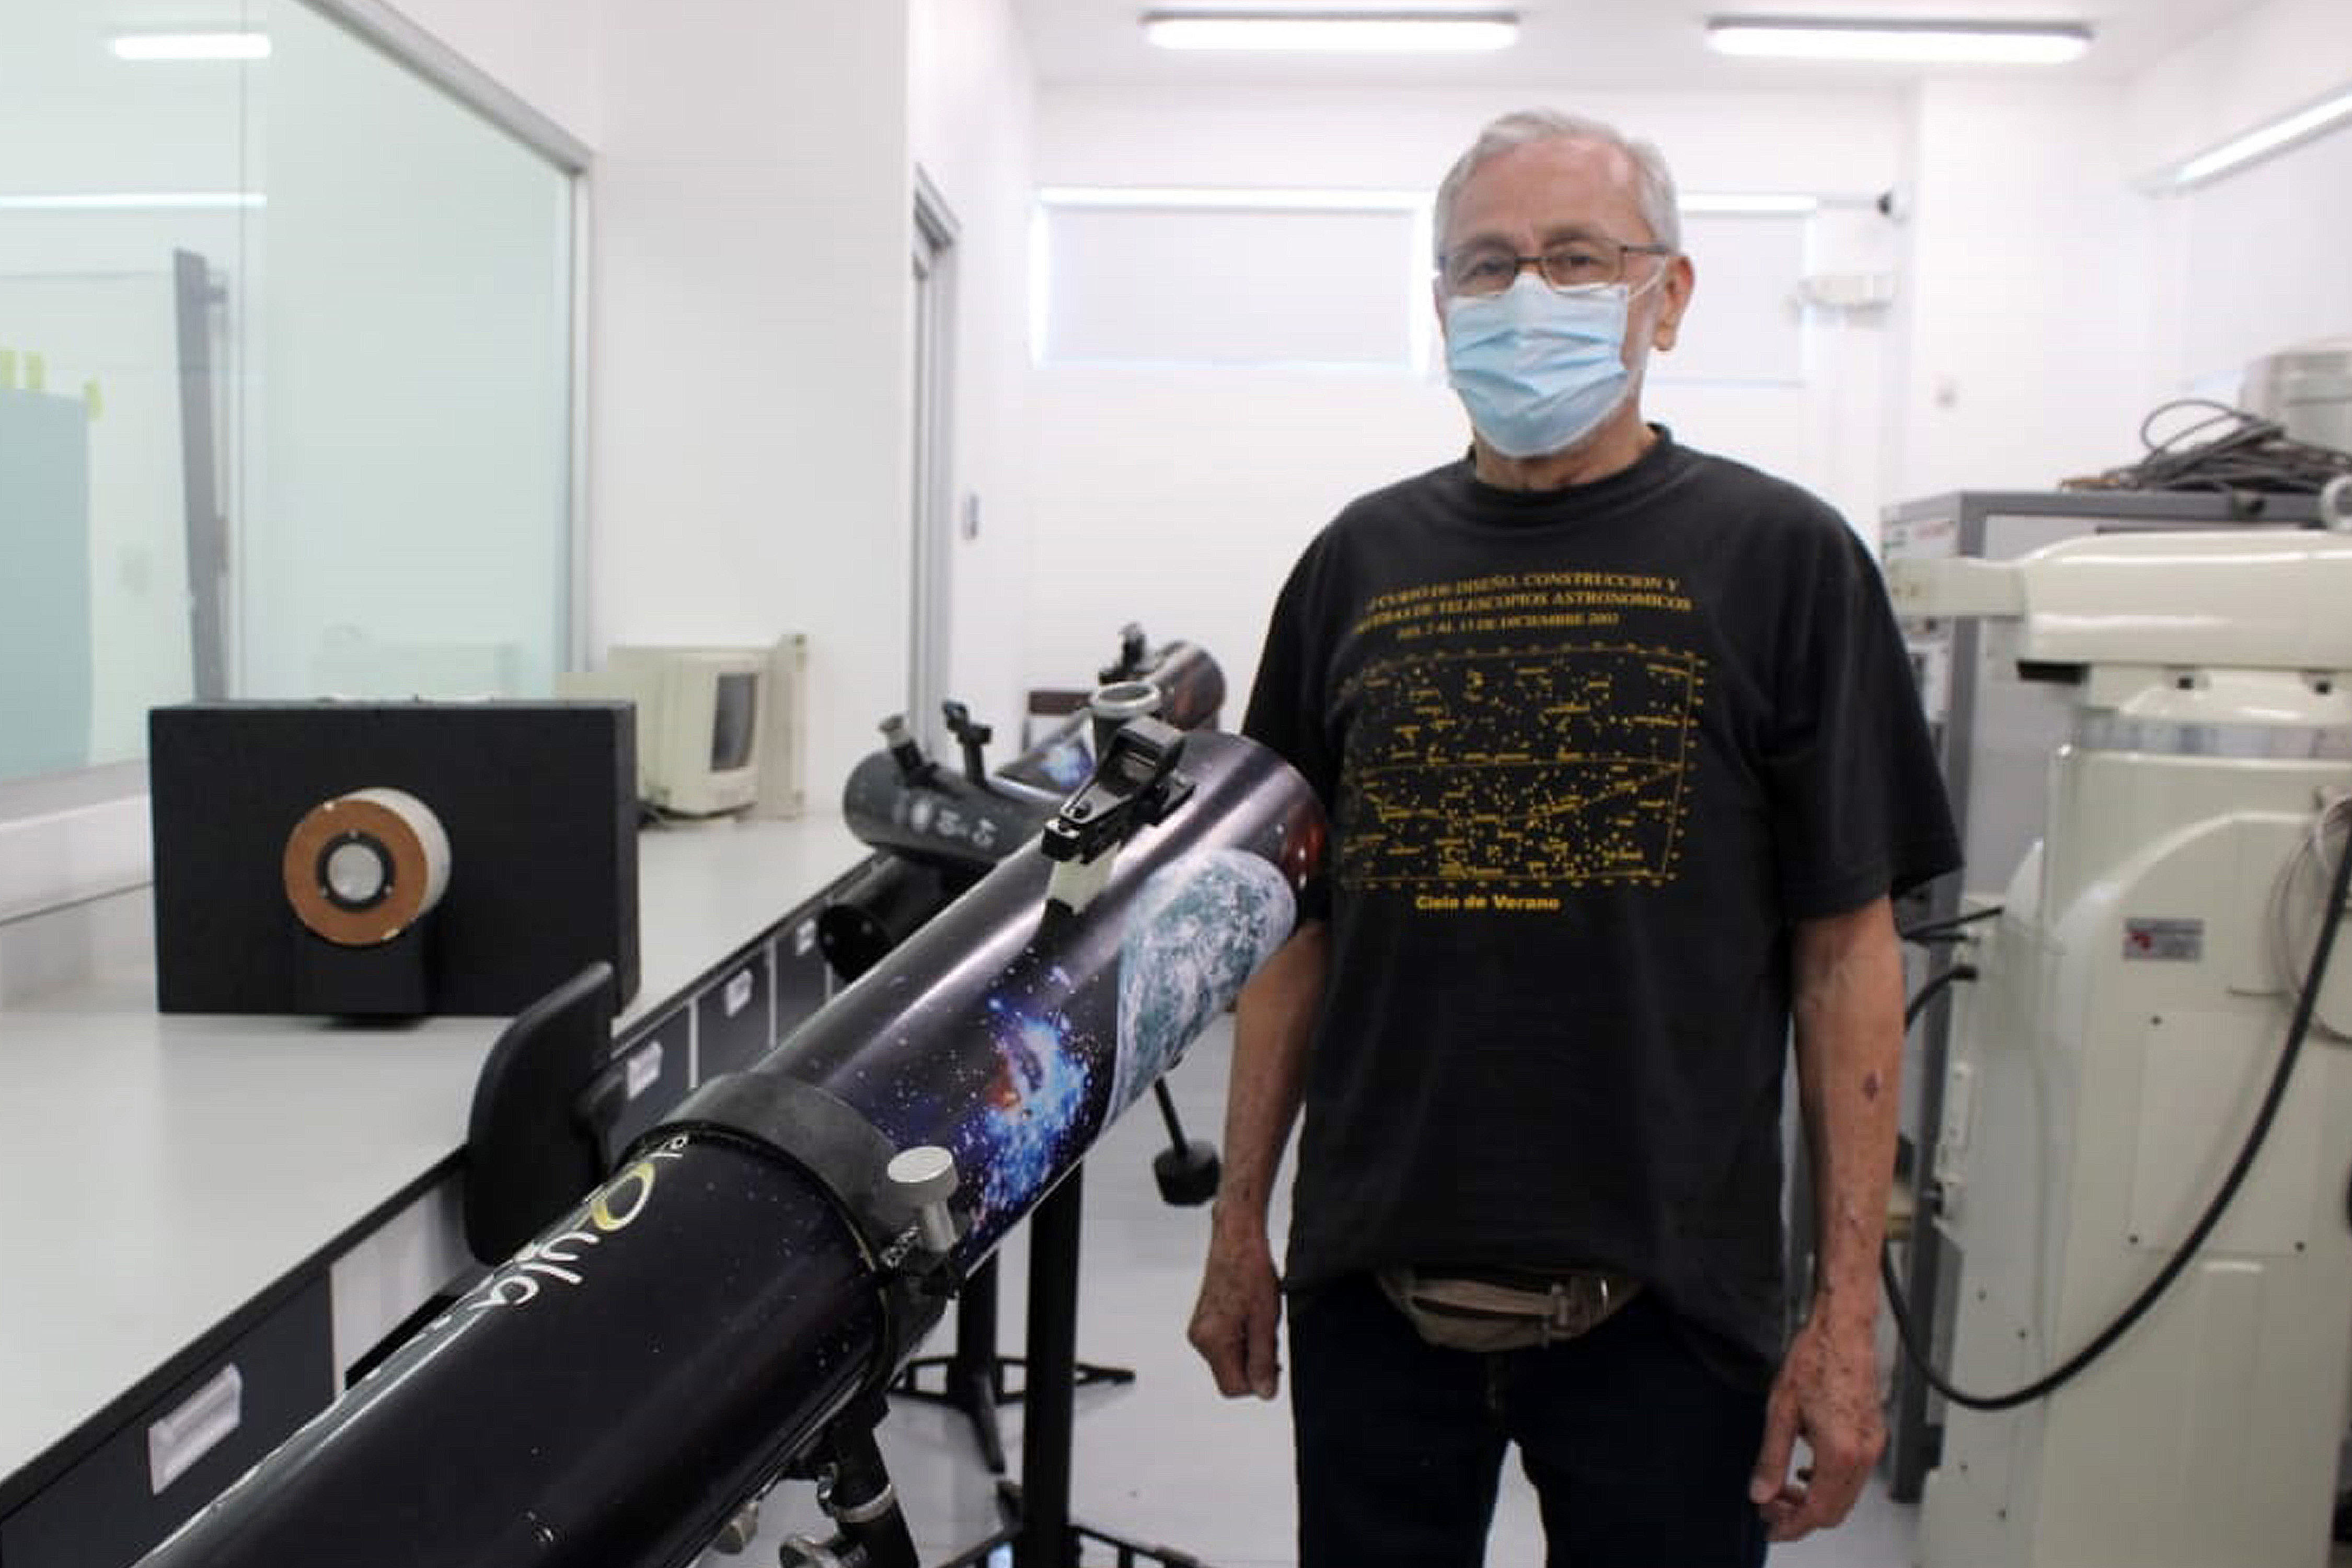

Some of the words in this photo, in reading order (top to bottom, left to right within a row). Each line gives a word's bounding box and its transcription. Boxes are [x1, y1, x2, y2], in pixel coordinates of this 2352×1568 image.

[1667, 577, 1681, 592] Y
[1463, 894, 1488, 909] de
[1491, 894, 1561, 910] Verano
